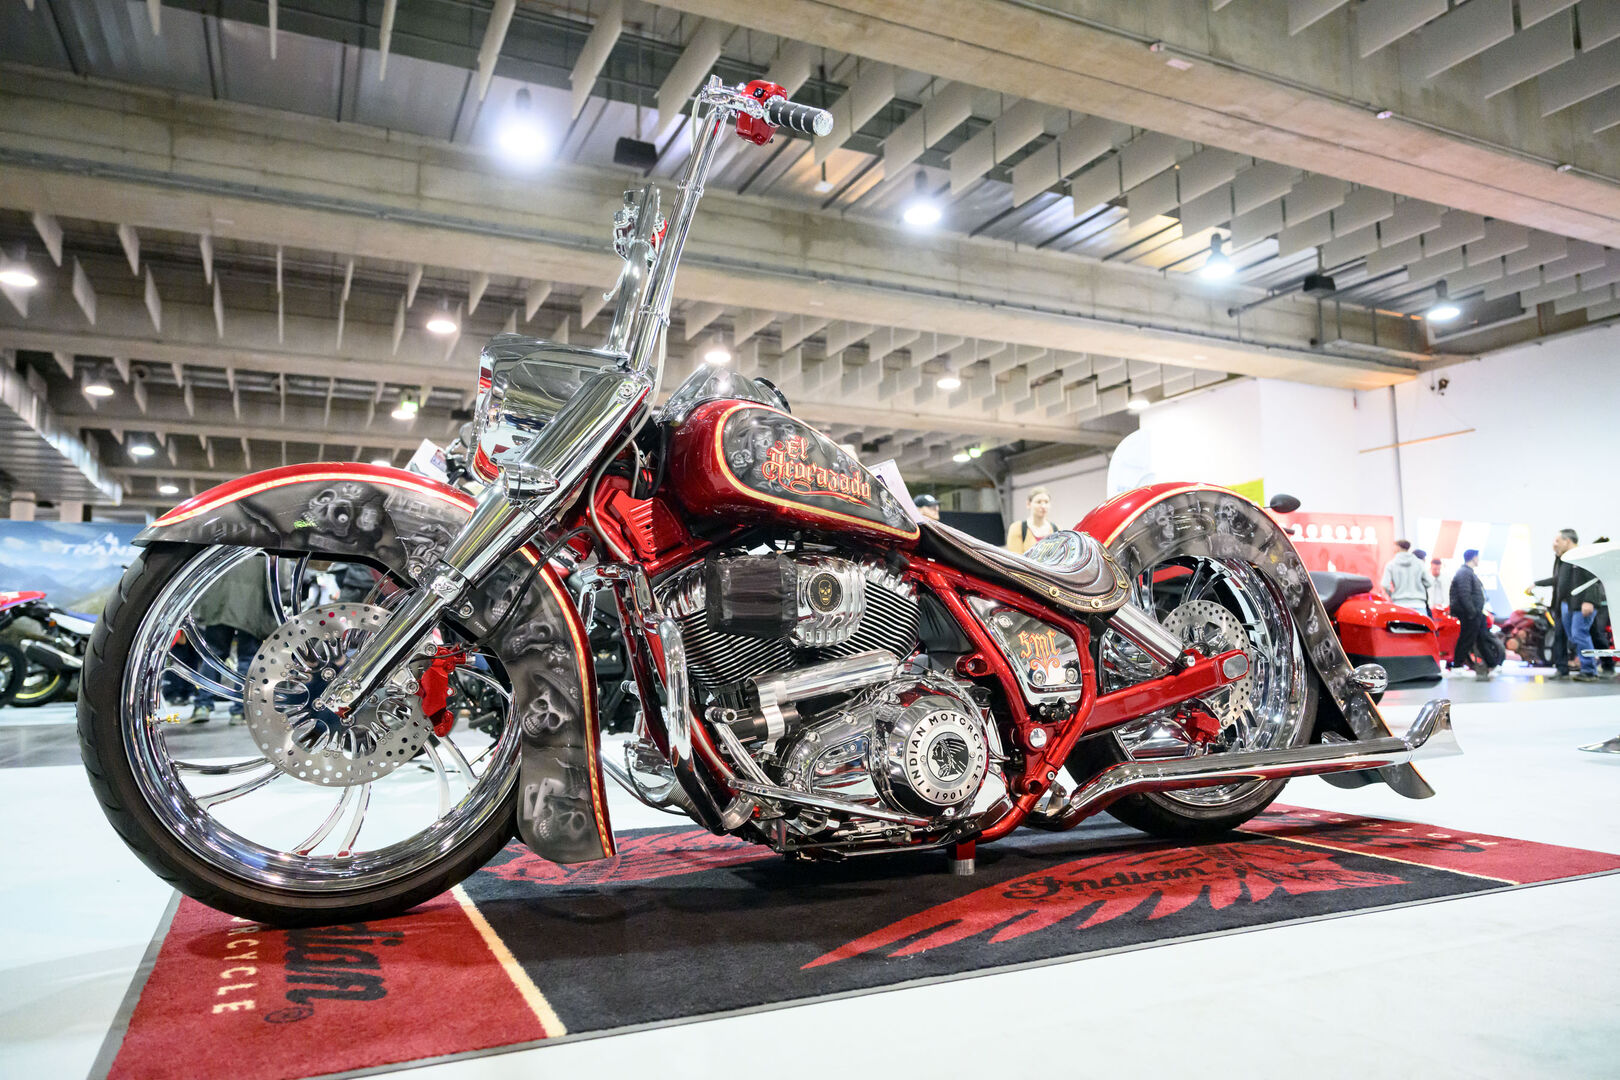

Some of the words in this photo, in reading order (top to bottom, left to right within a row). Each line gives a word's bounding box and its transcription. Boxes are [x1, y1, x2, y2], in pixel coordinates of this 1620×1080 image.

[785, 434, 809, 461] El
[909, 726, 926, 786] INDIAN
[928, 713, 984, 781] MOTORCYCLE
[934, 788, 963, 800] 1901
[1001, 866, 1209, 900] Indian
